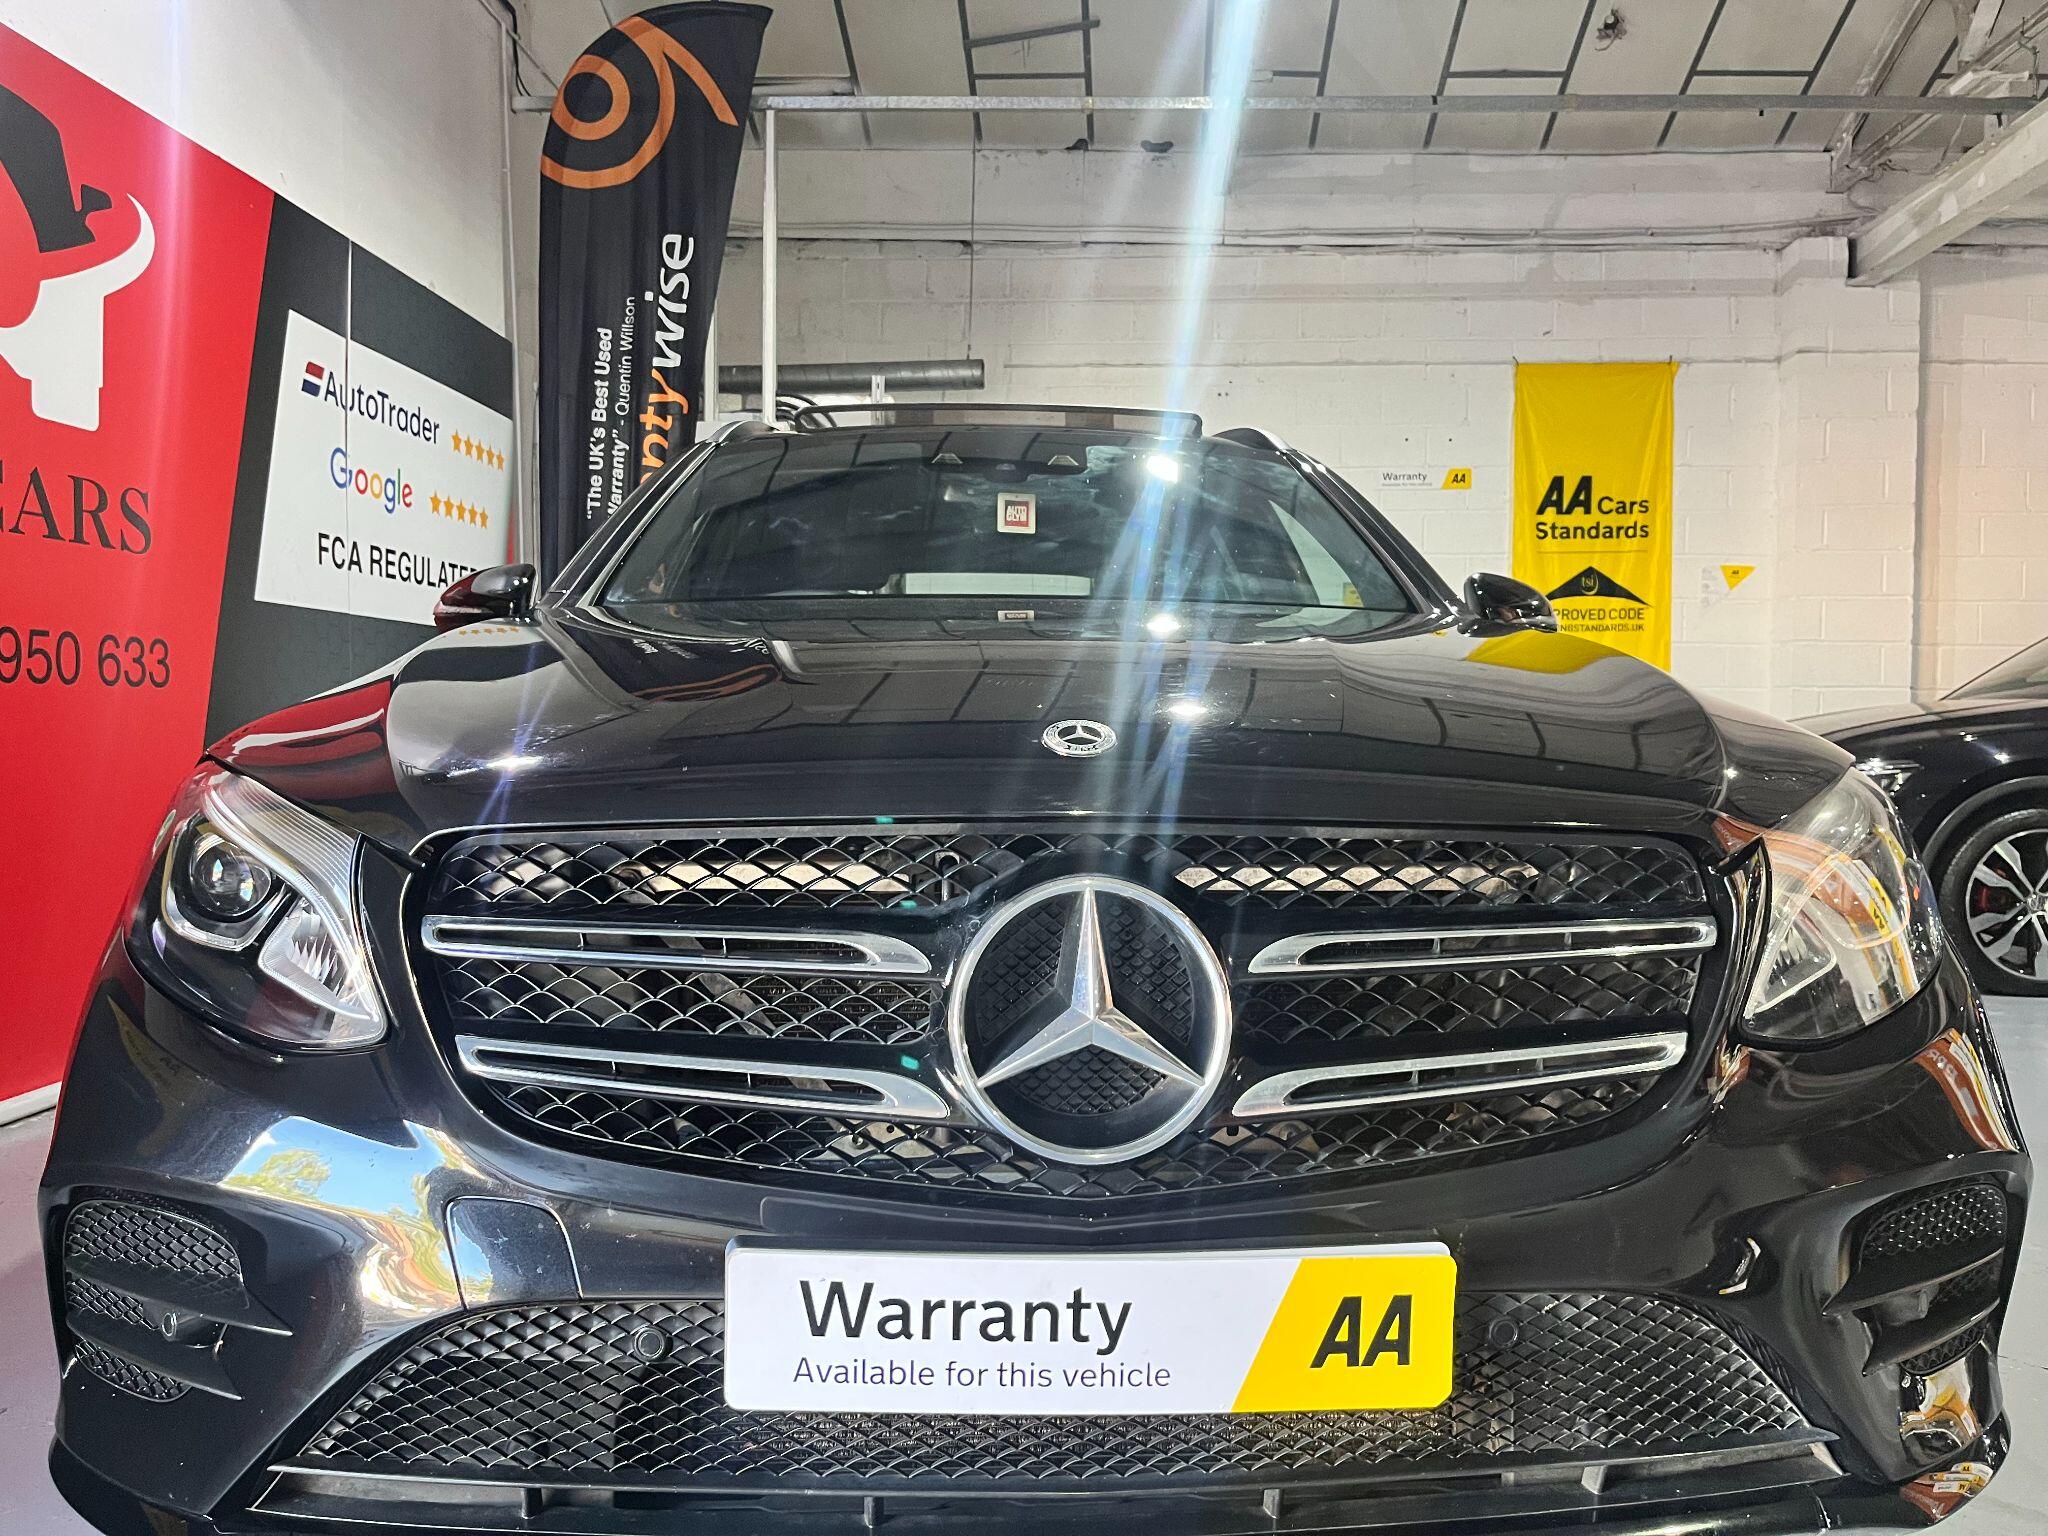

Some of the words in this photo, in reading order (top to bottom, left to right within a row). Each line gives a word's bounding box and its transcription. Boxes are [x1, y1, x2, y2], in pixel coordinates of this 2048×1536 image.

[594, 327, 612, 376] Used
[620, 296, 636, 351] Willson
[615, 355, 632, 416] Quentin
[640, 233, 694, 485] ntywise
[323, 370, 440, 445] AutoTrader
[591, 380, 609, 422] Best
[330, 446, 413, 514] Google
[1382, 472, 1428, 483] Warranty
[1451, 473, 1466, 484] AA
[1536, 475, 1592, 516] AA
[1597, 495, 1649, 515] Cars
[0, 459, 152, 555] ARS
[1535, 521, 1650, 541] Standards
[318, 532, 363, 574] FCA
[369, 544, 478, 589] REGULAT
[1608, 607, 1645, 621] CODE
[0, 626, 81, 686] 950
[98, 634, 170, 688] 633
[799, 1280, 1132, 1355] Warranty
[1308, 1295, 1413, 1369] AA
[792, 1357, 936, 1388] Available
[944, 1359, 989, 1387] for
[996, 1361, 1053, 1388] this
[1063, 1361, 1171, 1389] vehicle
